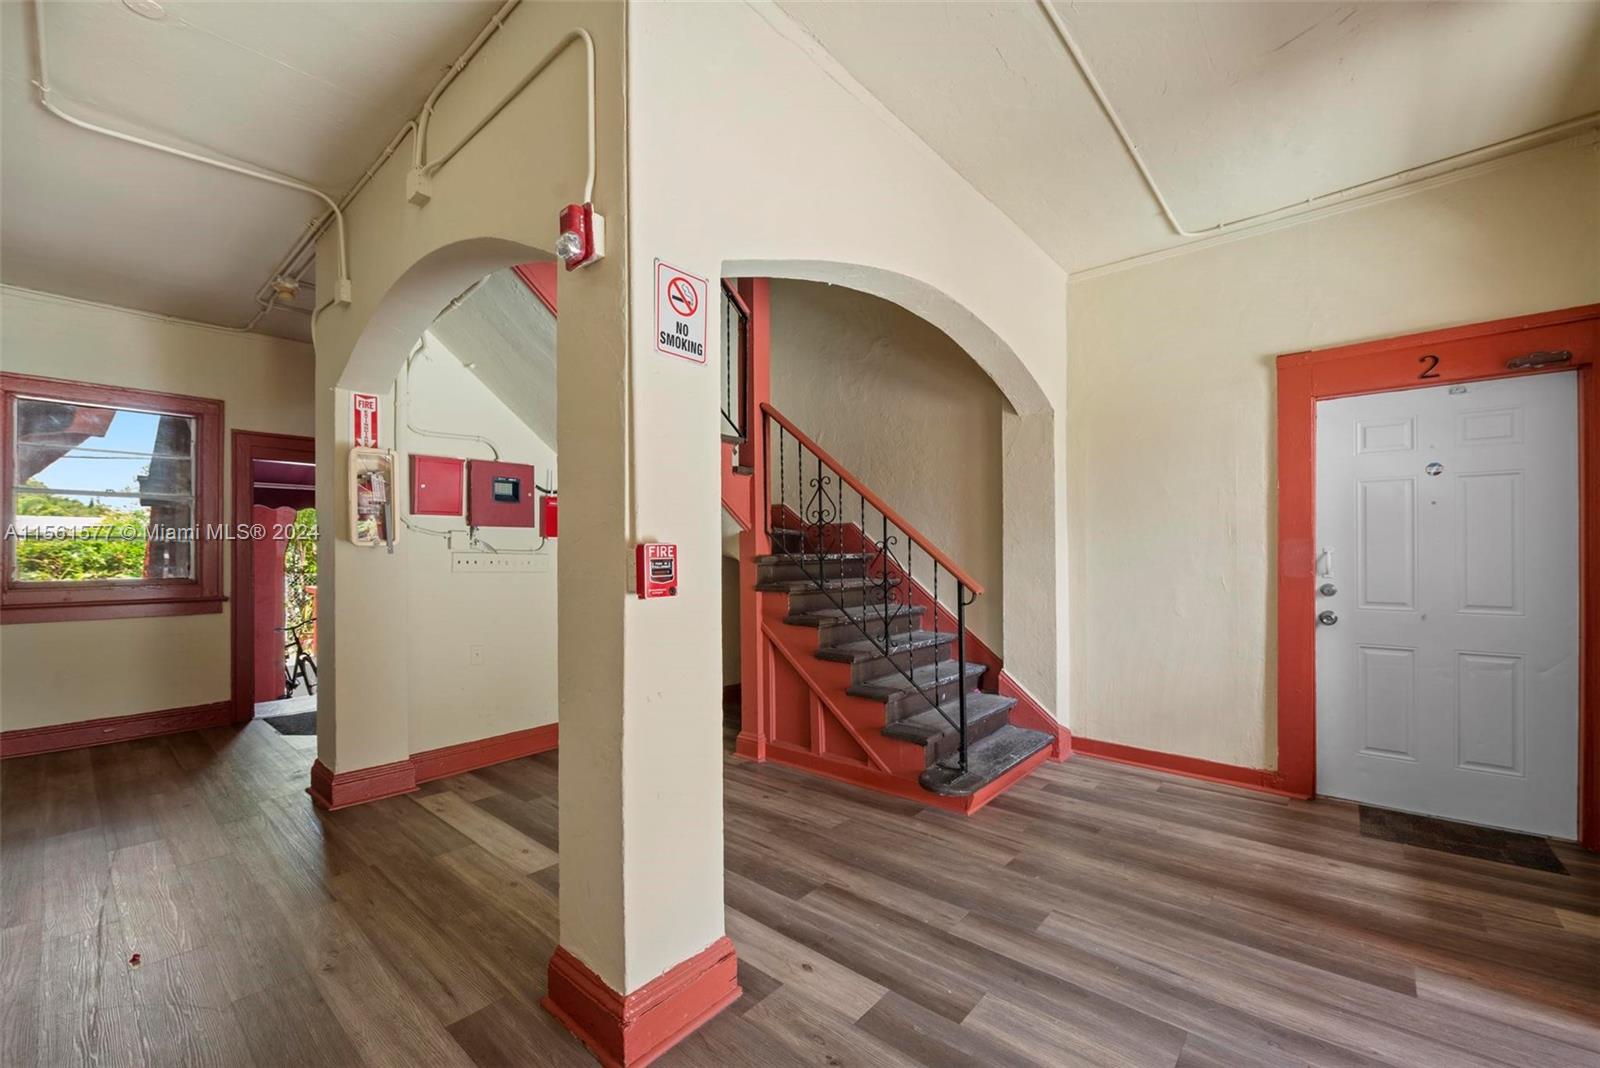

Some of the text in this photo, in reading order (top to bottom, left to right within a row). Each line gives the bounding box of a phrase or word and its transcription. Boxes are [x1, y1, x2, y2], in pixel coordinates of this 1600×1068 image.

[676, 321, 689, 337] NO
[660, 331, 703, 356] SMOKING
[1418, 354, 1441, 379] 2
[358, 400, 374, 410] FIRE
[648, 545, 674, 558] FIRE
